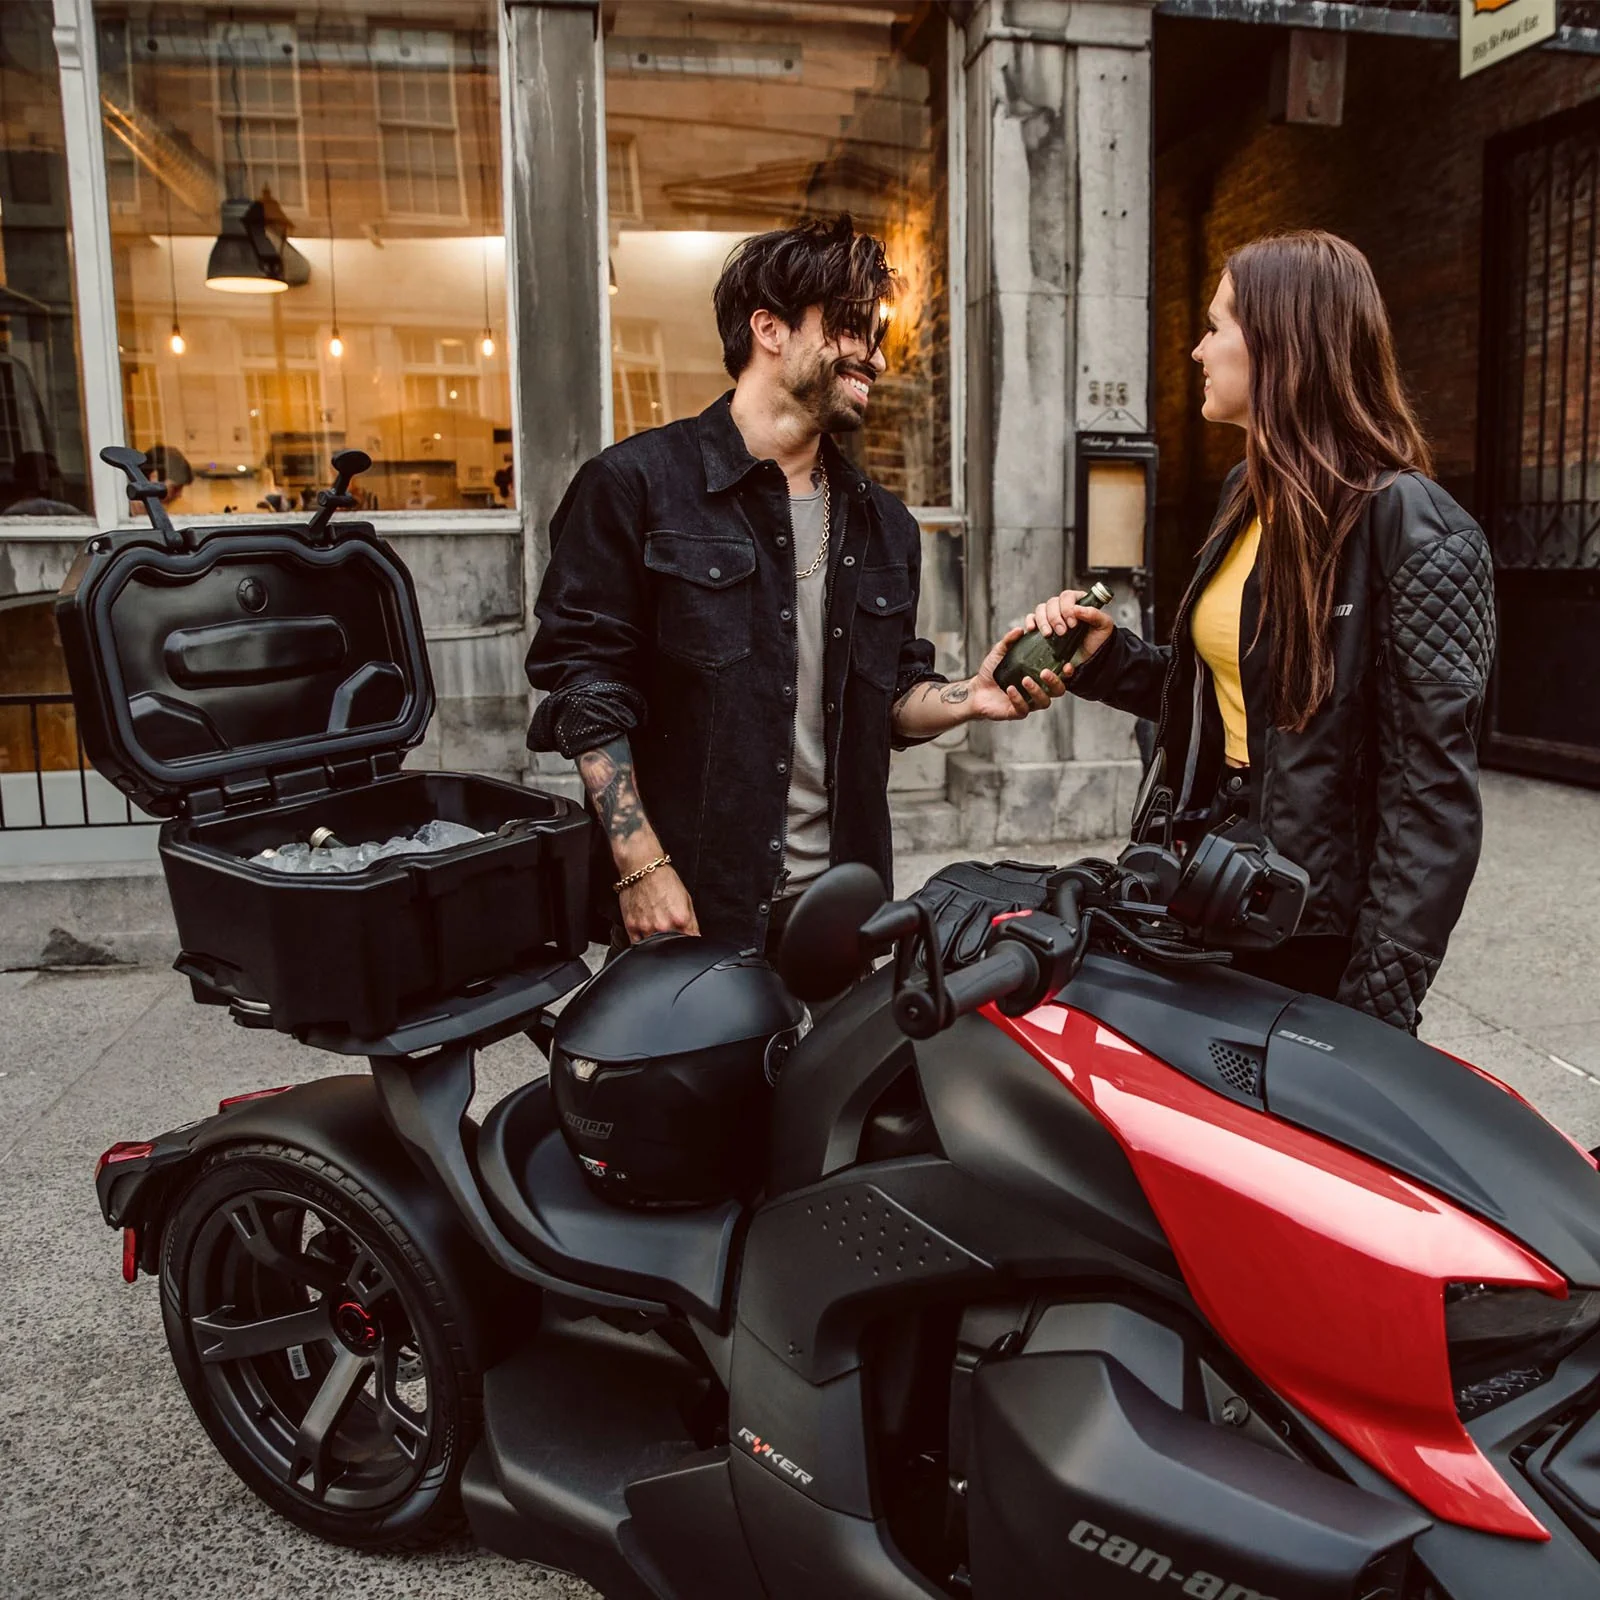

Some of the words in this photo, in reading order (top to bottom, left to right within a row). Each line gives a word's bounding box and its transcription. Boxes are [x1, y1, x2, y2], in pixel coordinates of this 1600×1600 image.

[1334, 603, 1354, 617] m
[1278, 1029, 1335, 1052] 900
[738, 1427, 814, 1485] RYKER
